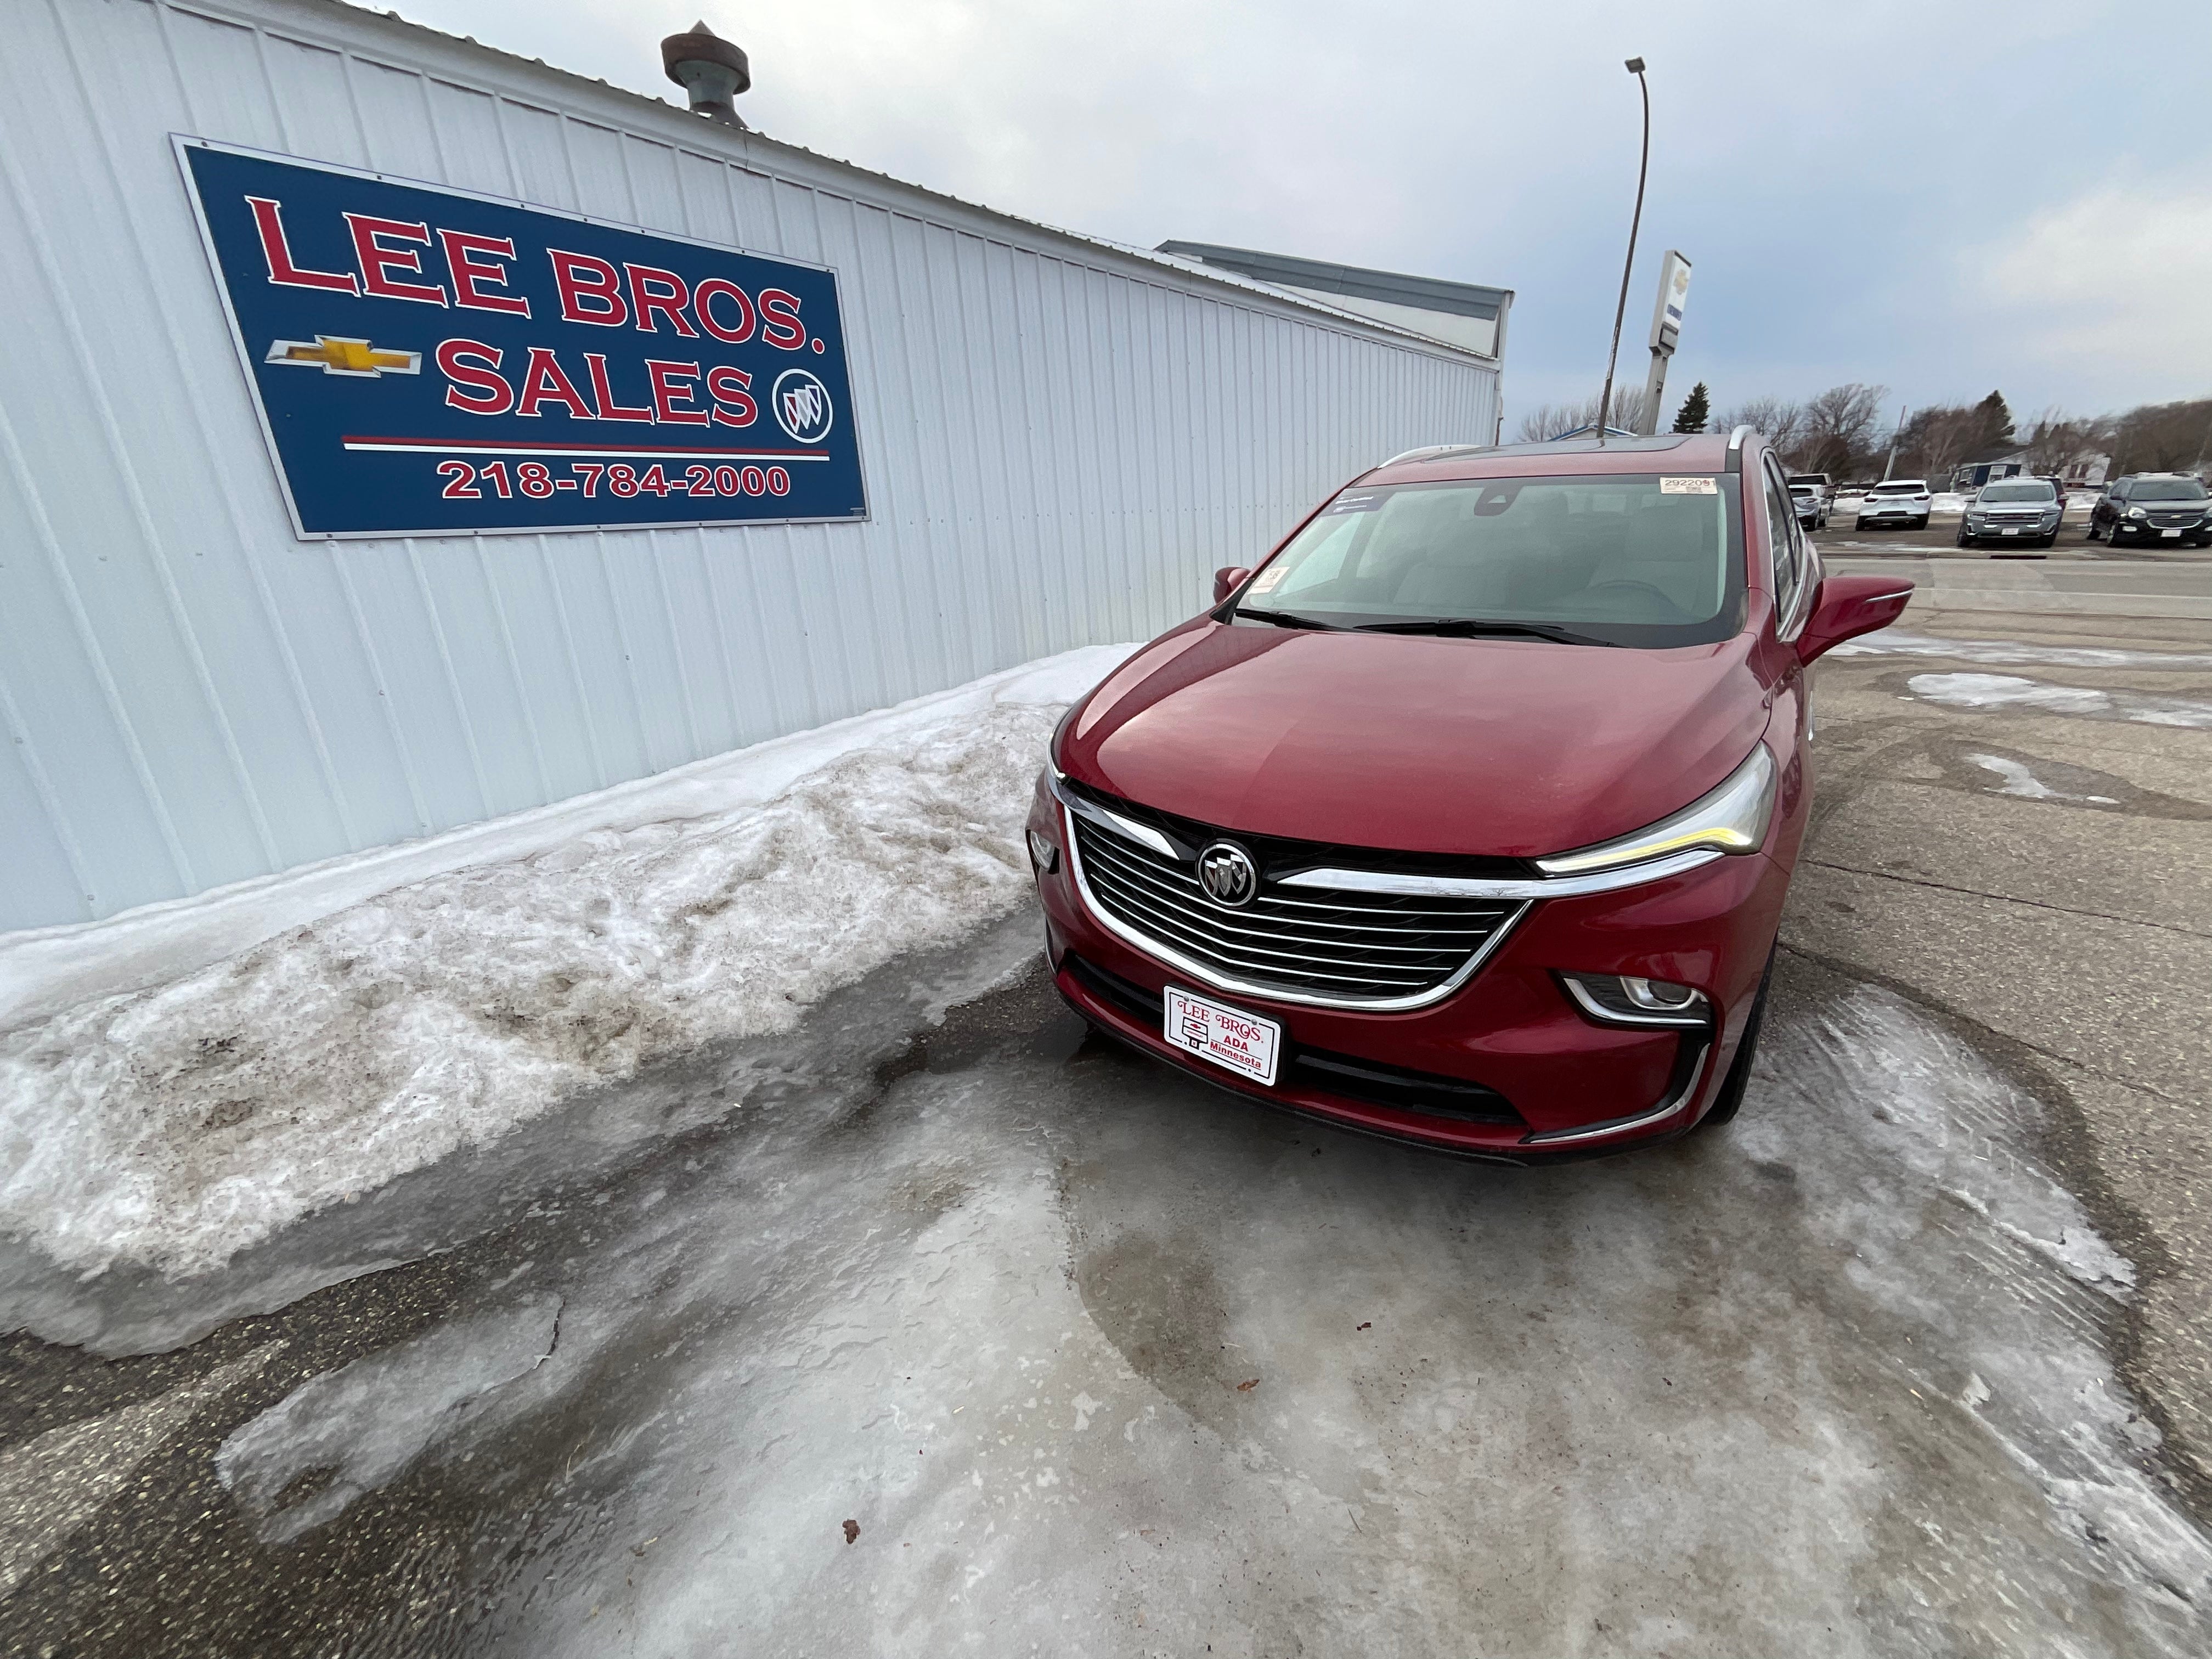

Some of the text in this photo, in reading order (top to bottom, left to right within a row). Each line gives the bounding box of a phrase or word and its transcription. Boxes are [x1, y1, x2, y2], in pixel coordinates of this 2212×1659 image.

[244, 195, 826, 354] LEE BROS.
[435, 338, 758, 428] SALES
[436, 460, 791, 499] 218-784-2000
[1177, 1001, 1264, 1043] LEE BROS.
[1210, 1041, 1262, 1069] Minnesota
[1223, 1035, 1249, 1052] ADA
